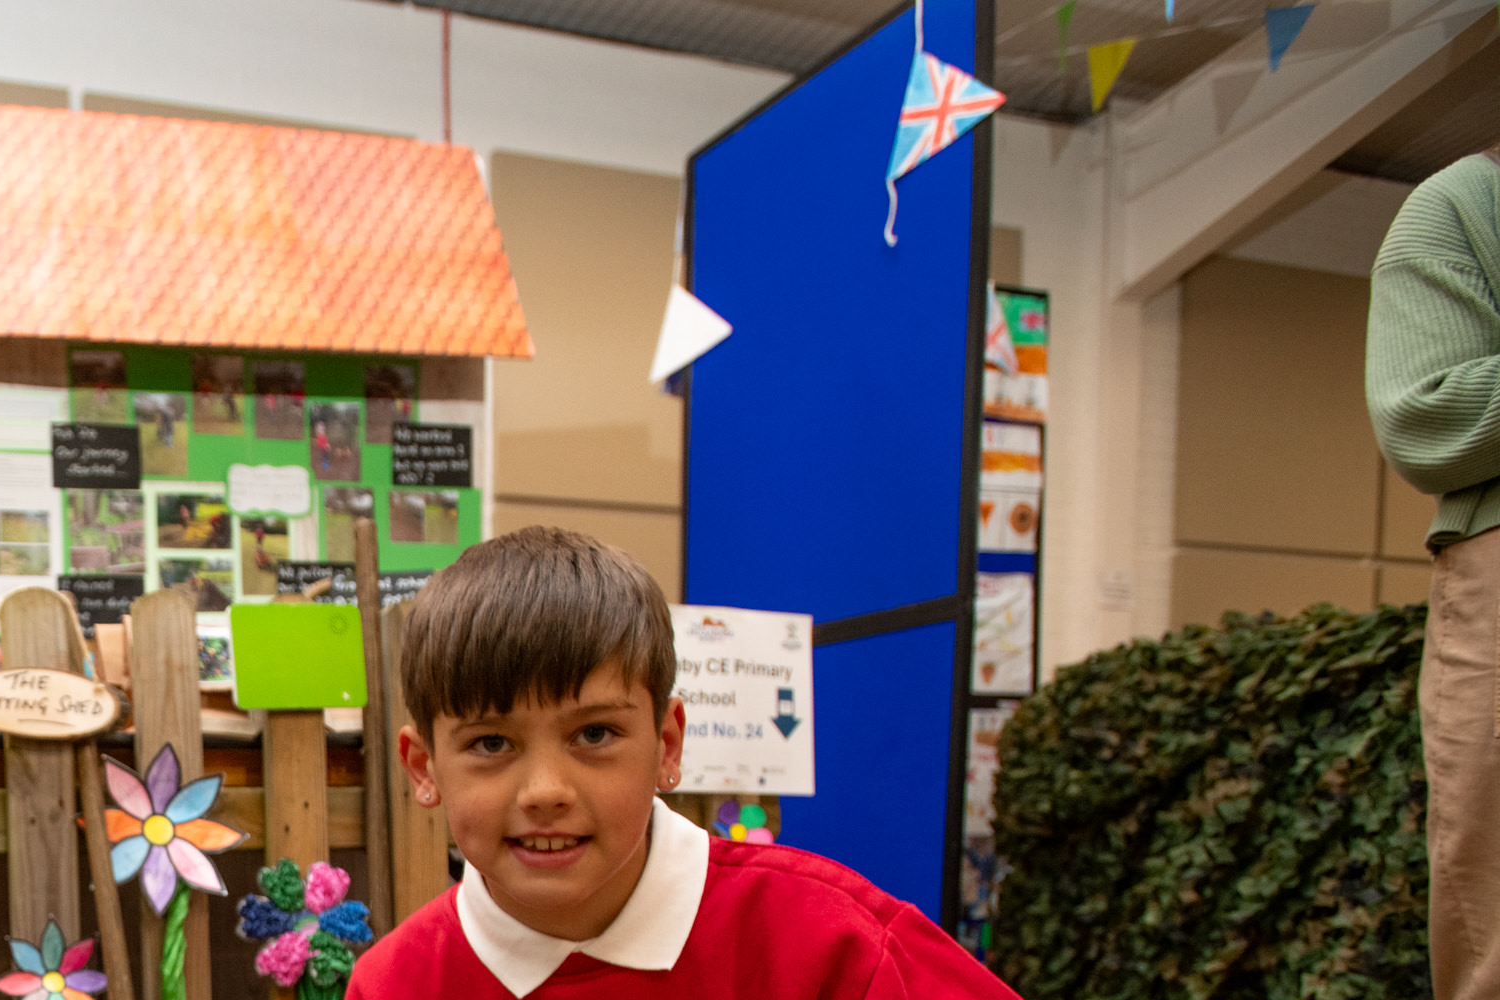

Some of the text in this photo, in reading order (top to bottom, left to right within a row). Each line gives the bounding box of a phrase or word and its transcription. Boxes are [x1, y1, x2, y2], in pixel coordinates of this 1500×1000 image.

[4, 669, 49, 690] THE
[706, 658, 730, 674] CE
[734, 659, 793, 682] Primary
[56, 694, 104, 715] SHED
[678, 689, 737, 706] School
